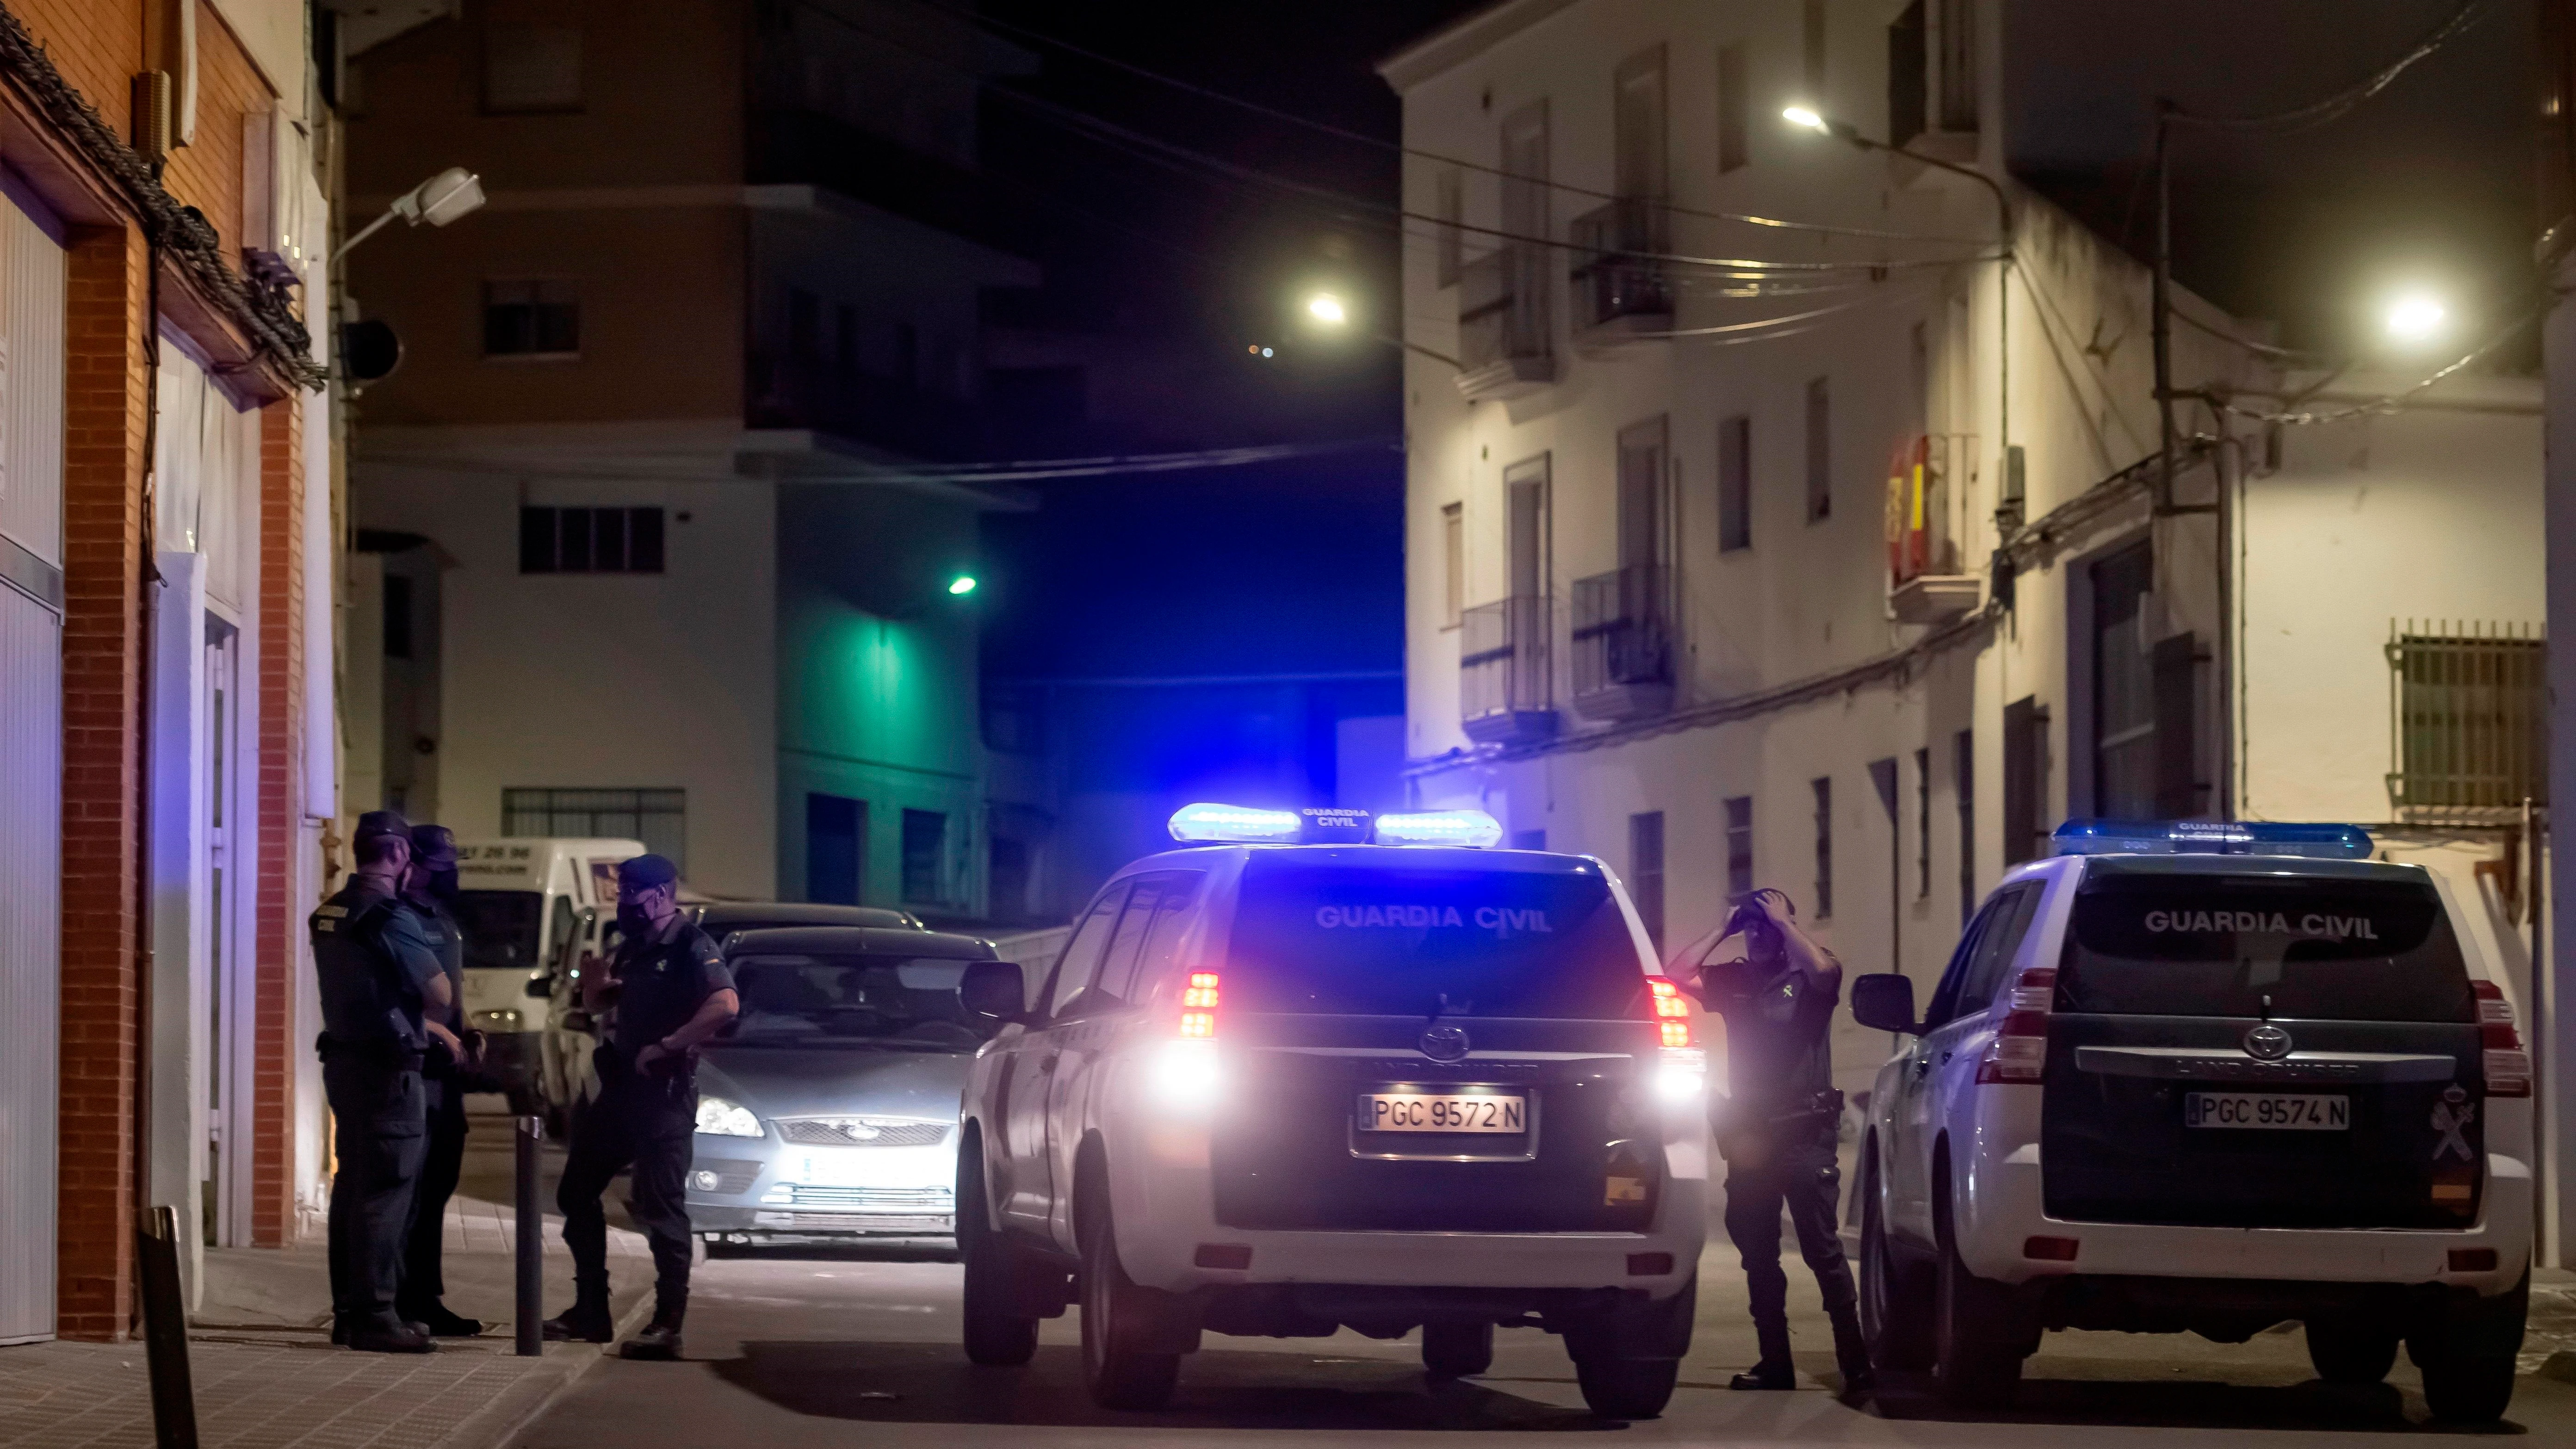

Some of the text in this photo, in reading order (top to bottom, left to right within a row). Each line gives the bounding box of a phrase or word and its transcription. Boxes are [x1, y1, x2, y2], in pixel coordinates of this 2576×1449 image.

[1302, 808, 1370, 817] GUARDIA
[1317, 817, 1358, 827] CIVIL
[1315, 905, 1553, 933] GUARDIA CIVIL
[2145, 910, 2378, 940] GUARDIA CIVIL
[1375, 1101, 1519, 1127] PGC 9572 N
[2202, 1098, 2346, 1125] PGC 9574 N
